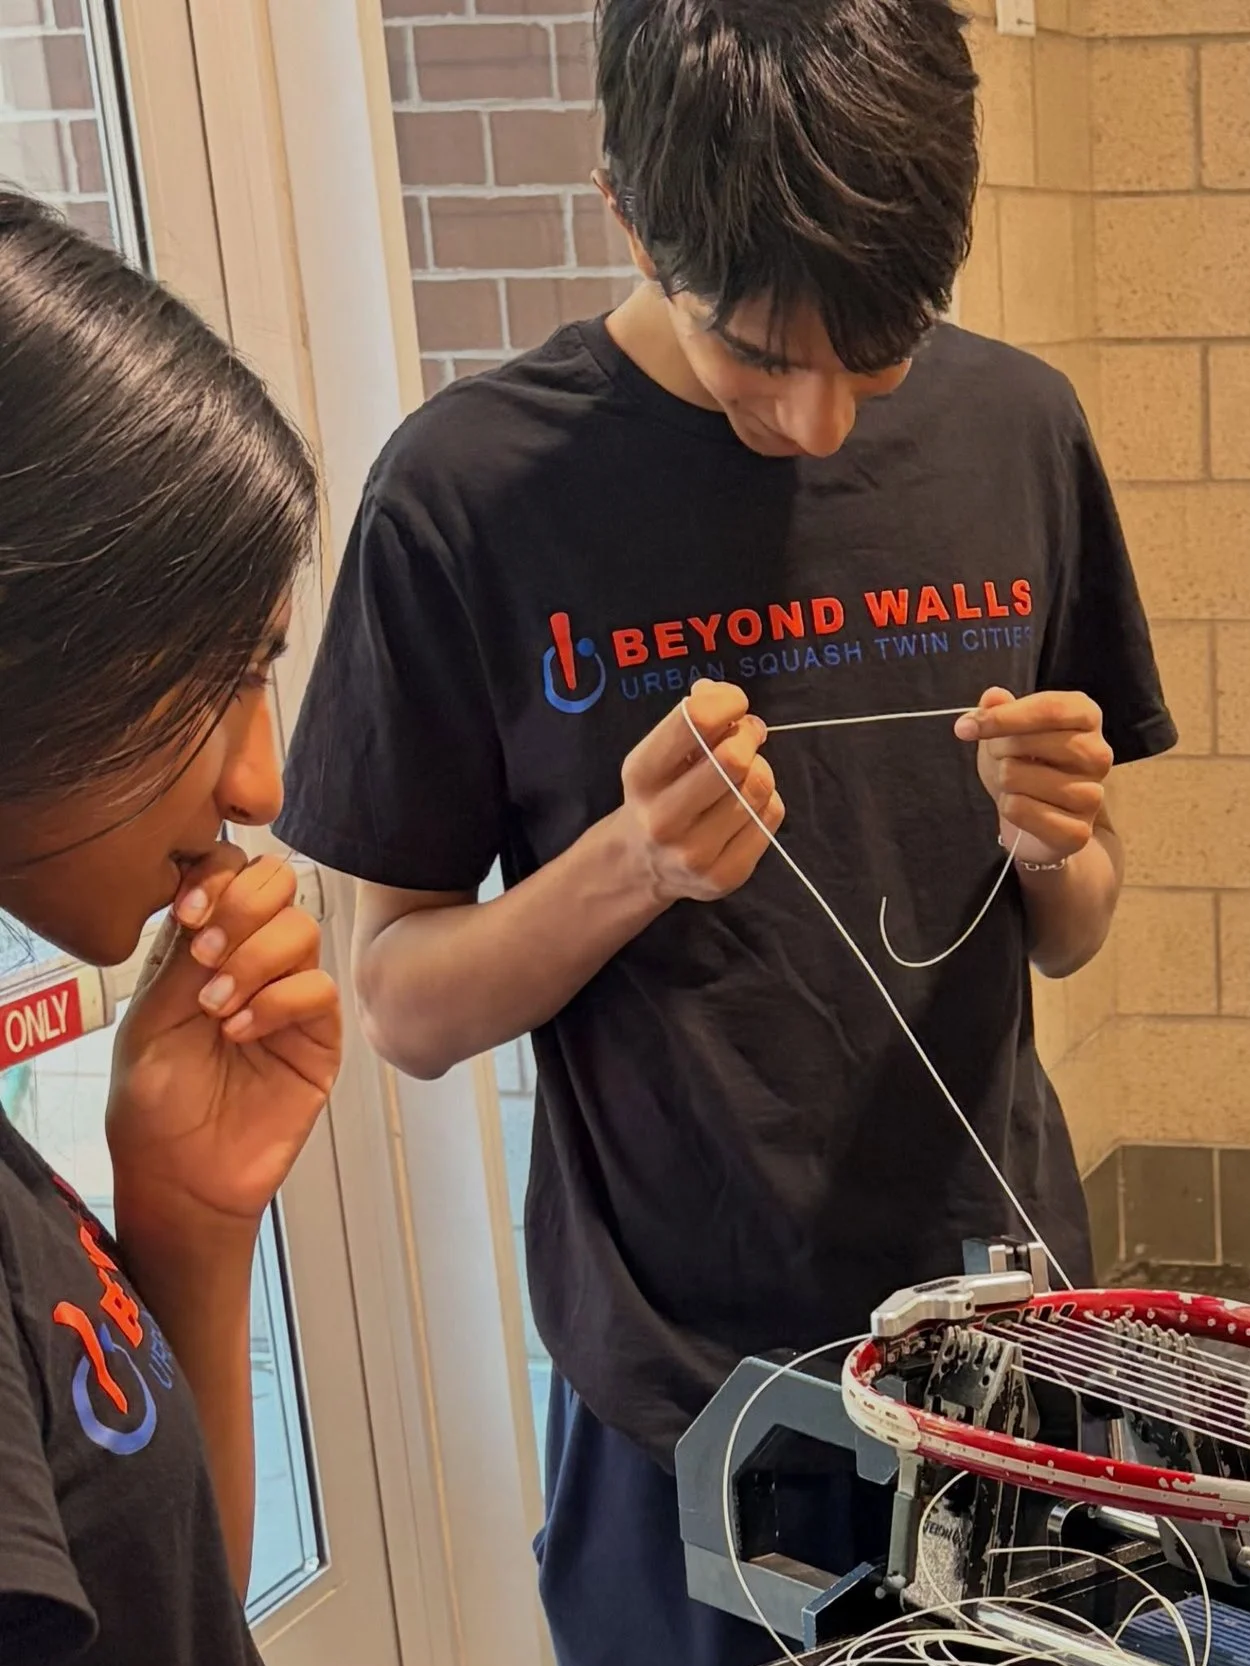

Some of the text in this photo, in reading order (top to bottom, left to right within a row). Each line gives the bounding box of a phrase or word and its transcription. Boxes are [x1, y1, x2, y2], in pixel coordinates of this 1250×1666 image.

[612, 578, 1034, 668] BEYOND WALLS
[740, 639, 862, 679] SQUASH
[874, 627, 950, 659] TWIN
[4, 989, 69, 1054] ONLY
